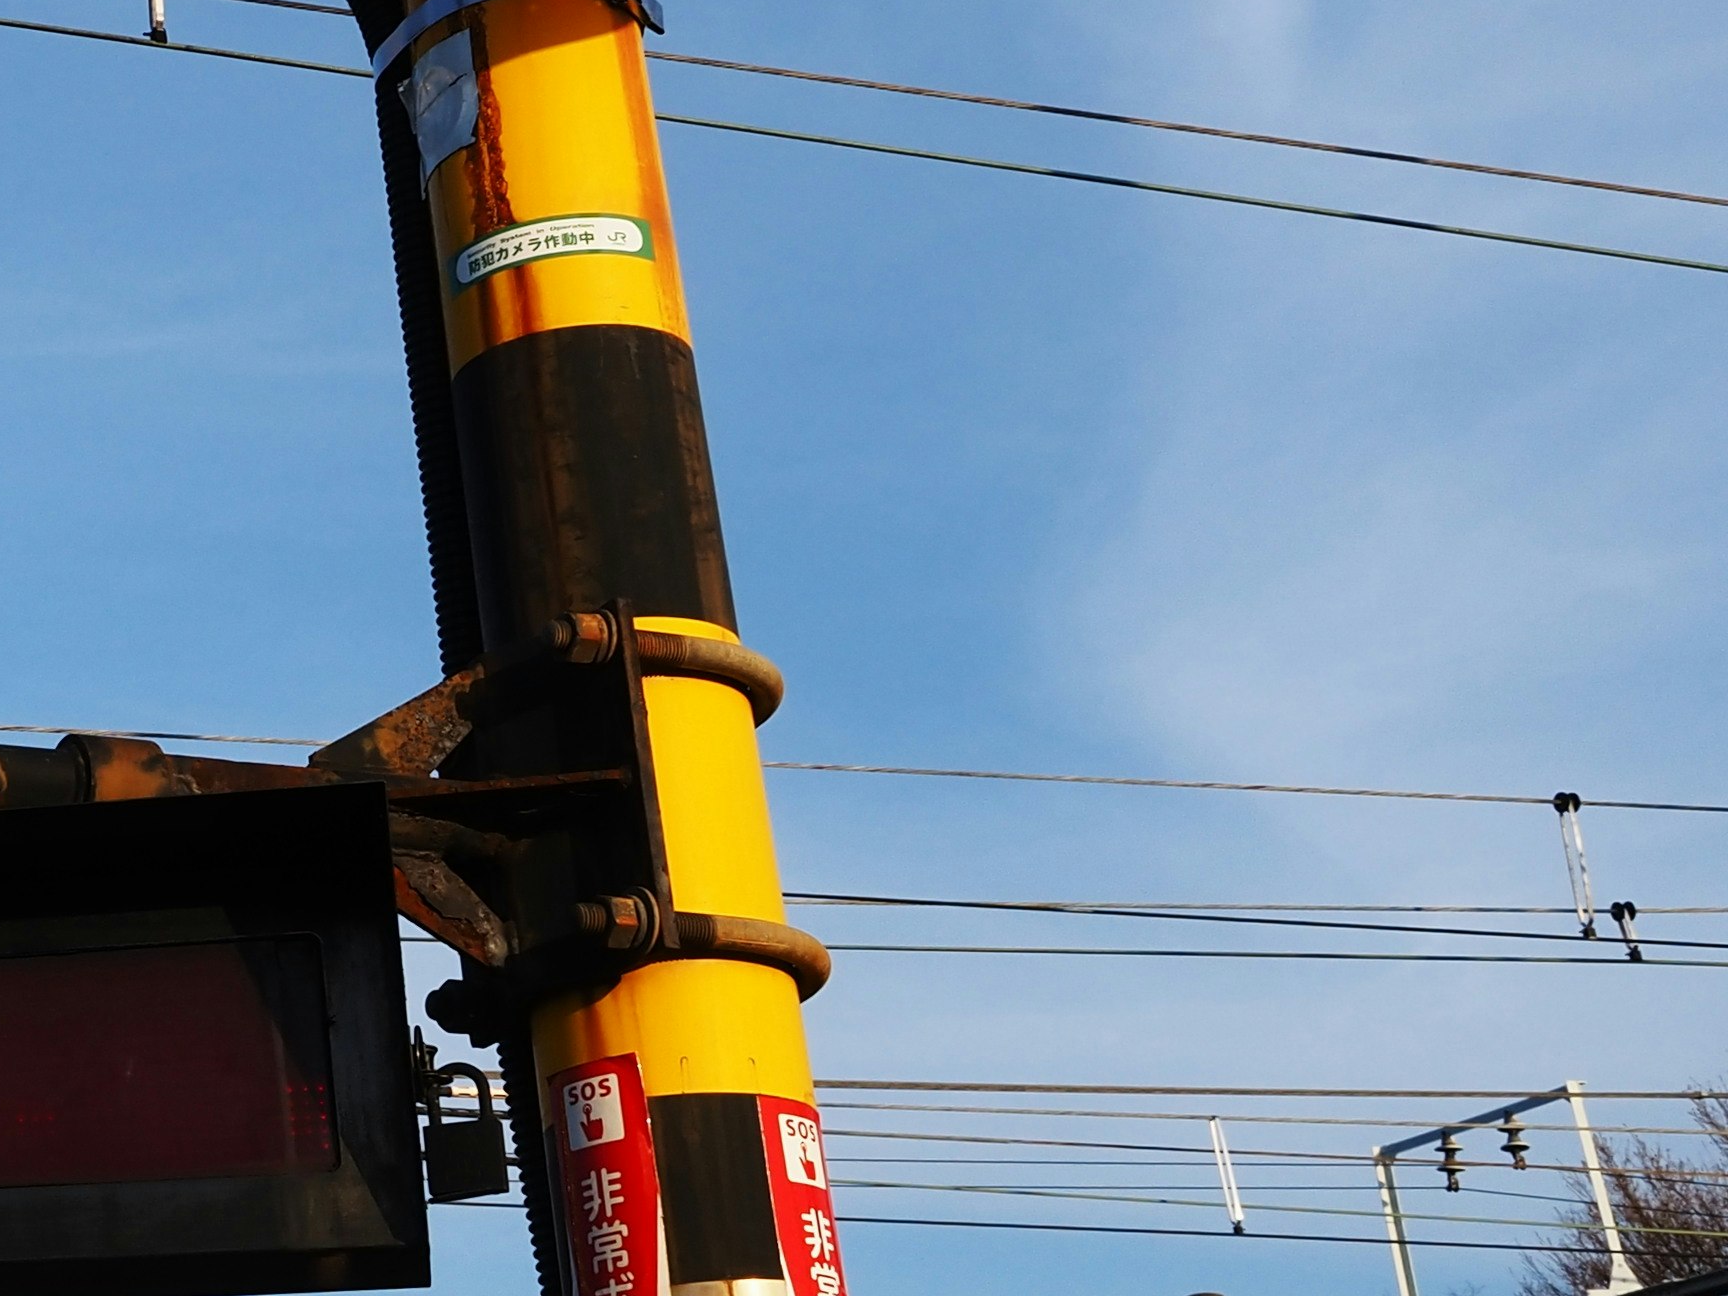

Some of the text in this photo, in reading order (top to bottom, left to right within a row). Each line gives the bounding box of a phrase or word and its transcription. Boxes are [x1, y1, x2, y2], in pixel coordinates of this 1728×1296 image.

[468, 231, 596, 276] 防犯カメラ作動中
[568, 1077, 612, 1105] SOS
[785, 1118, 816, 1143] SOS
